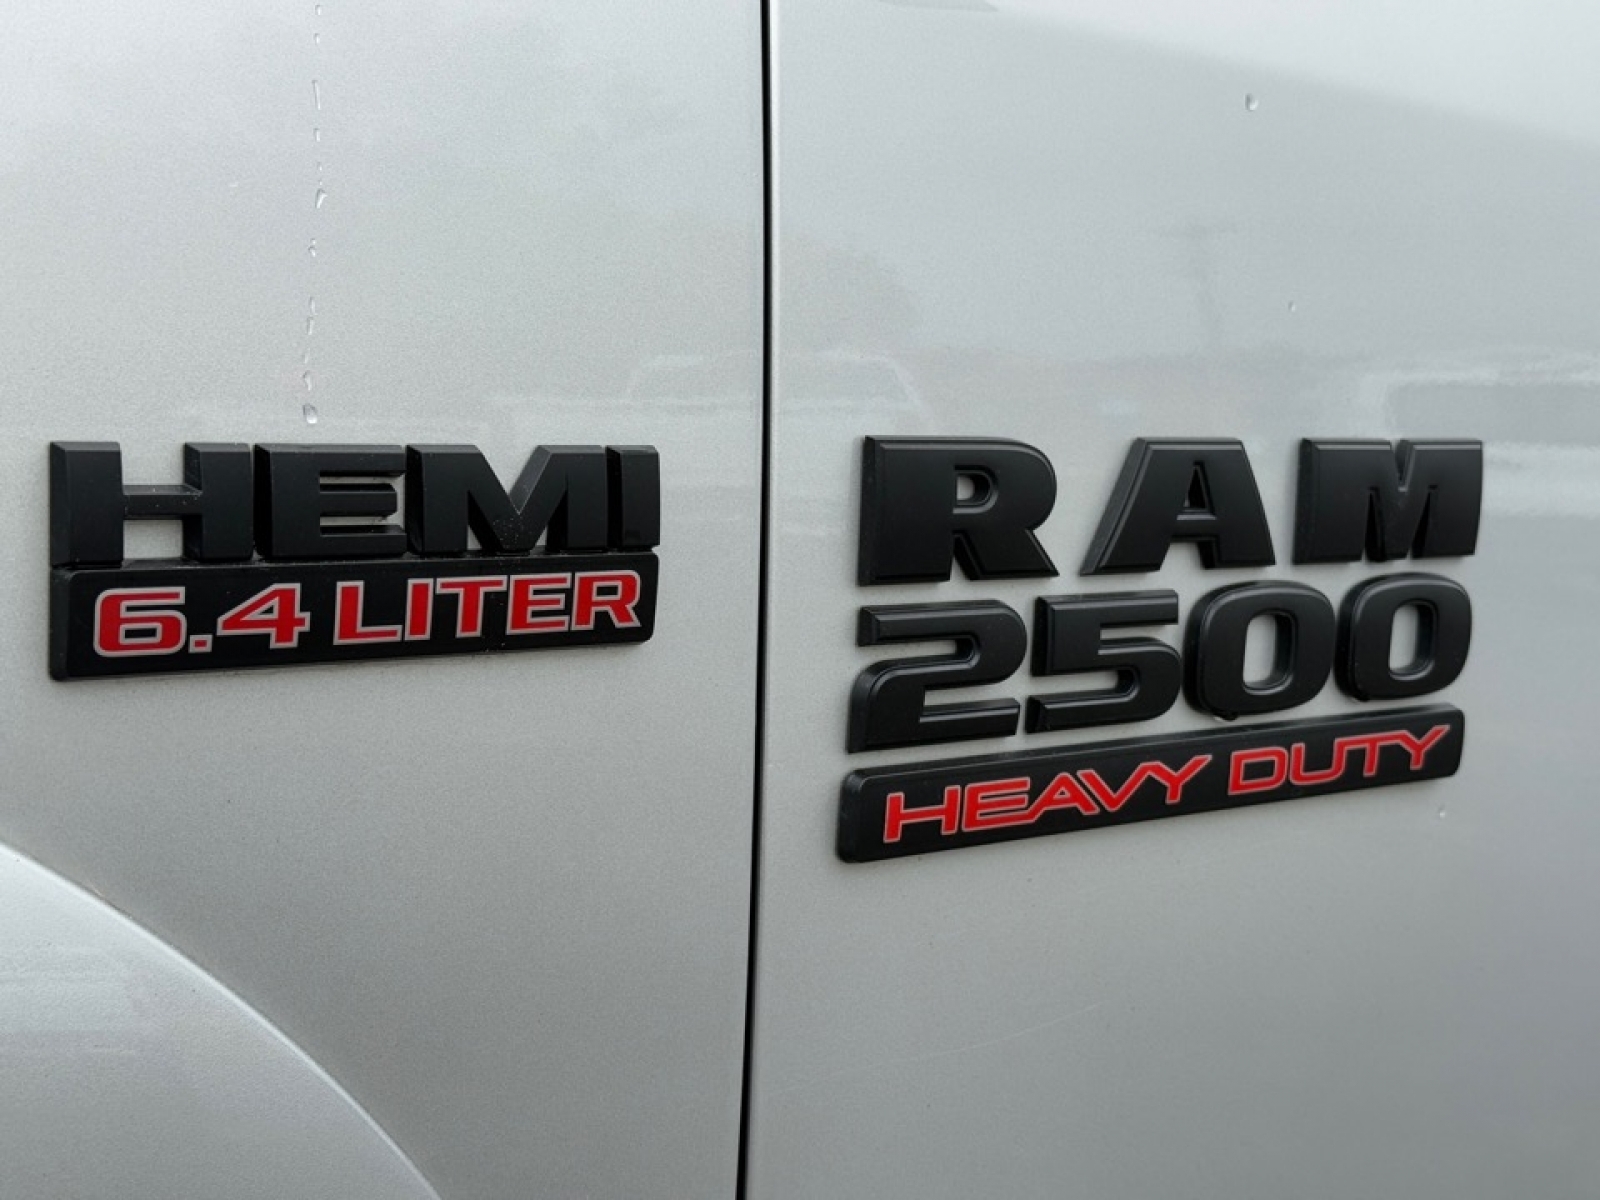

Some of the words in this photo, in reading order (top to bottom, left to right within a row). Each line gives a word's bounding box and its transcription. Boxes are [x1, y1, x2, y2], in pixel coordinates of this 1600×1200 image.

[50, 441, 660, 568] HEMI
[857, 435, 1483, 587] RAM
[94, 583, 310, 657] 6.4
[333, 570, 642, 646] LITER
[847, 572, 1472, 753] 2500
[883, 755, 1211, 843] HEAVY
[1227, 724, 1451, 795] DUTY
